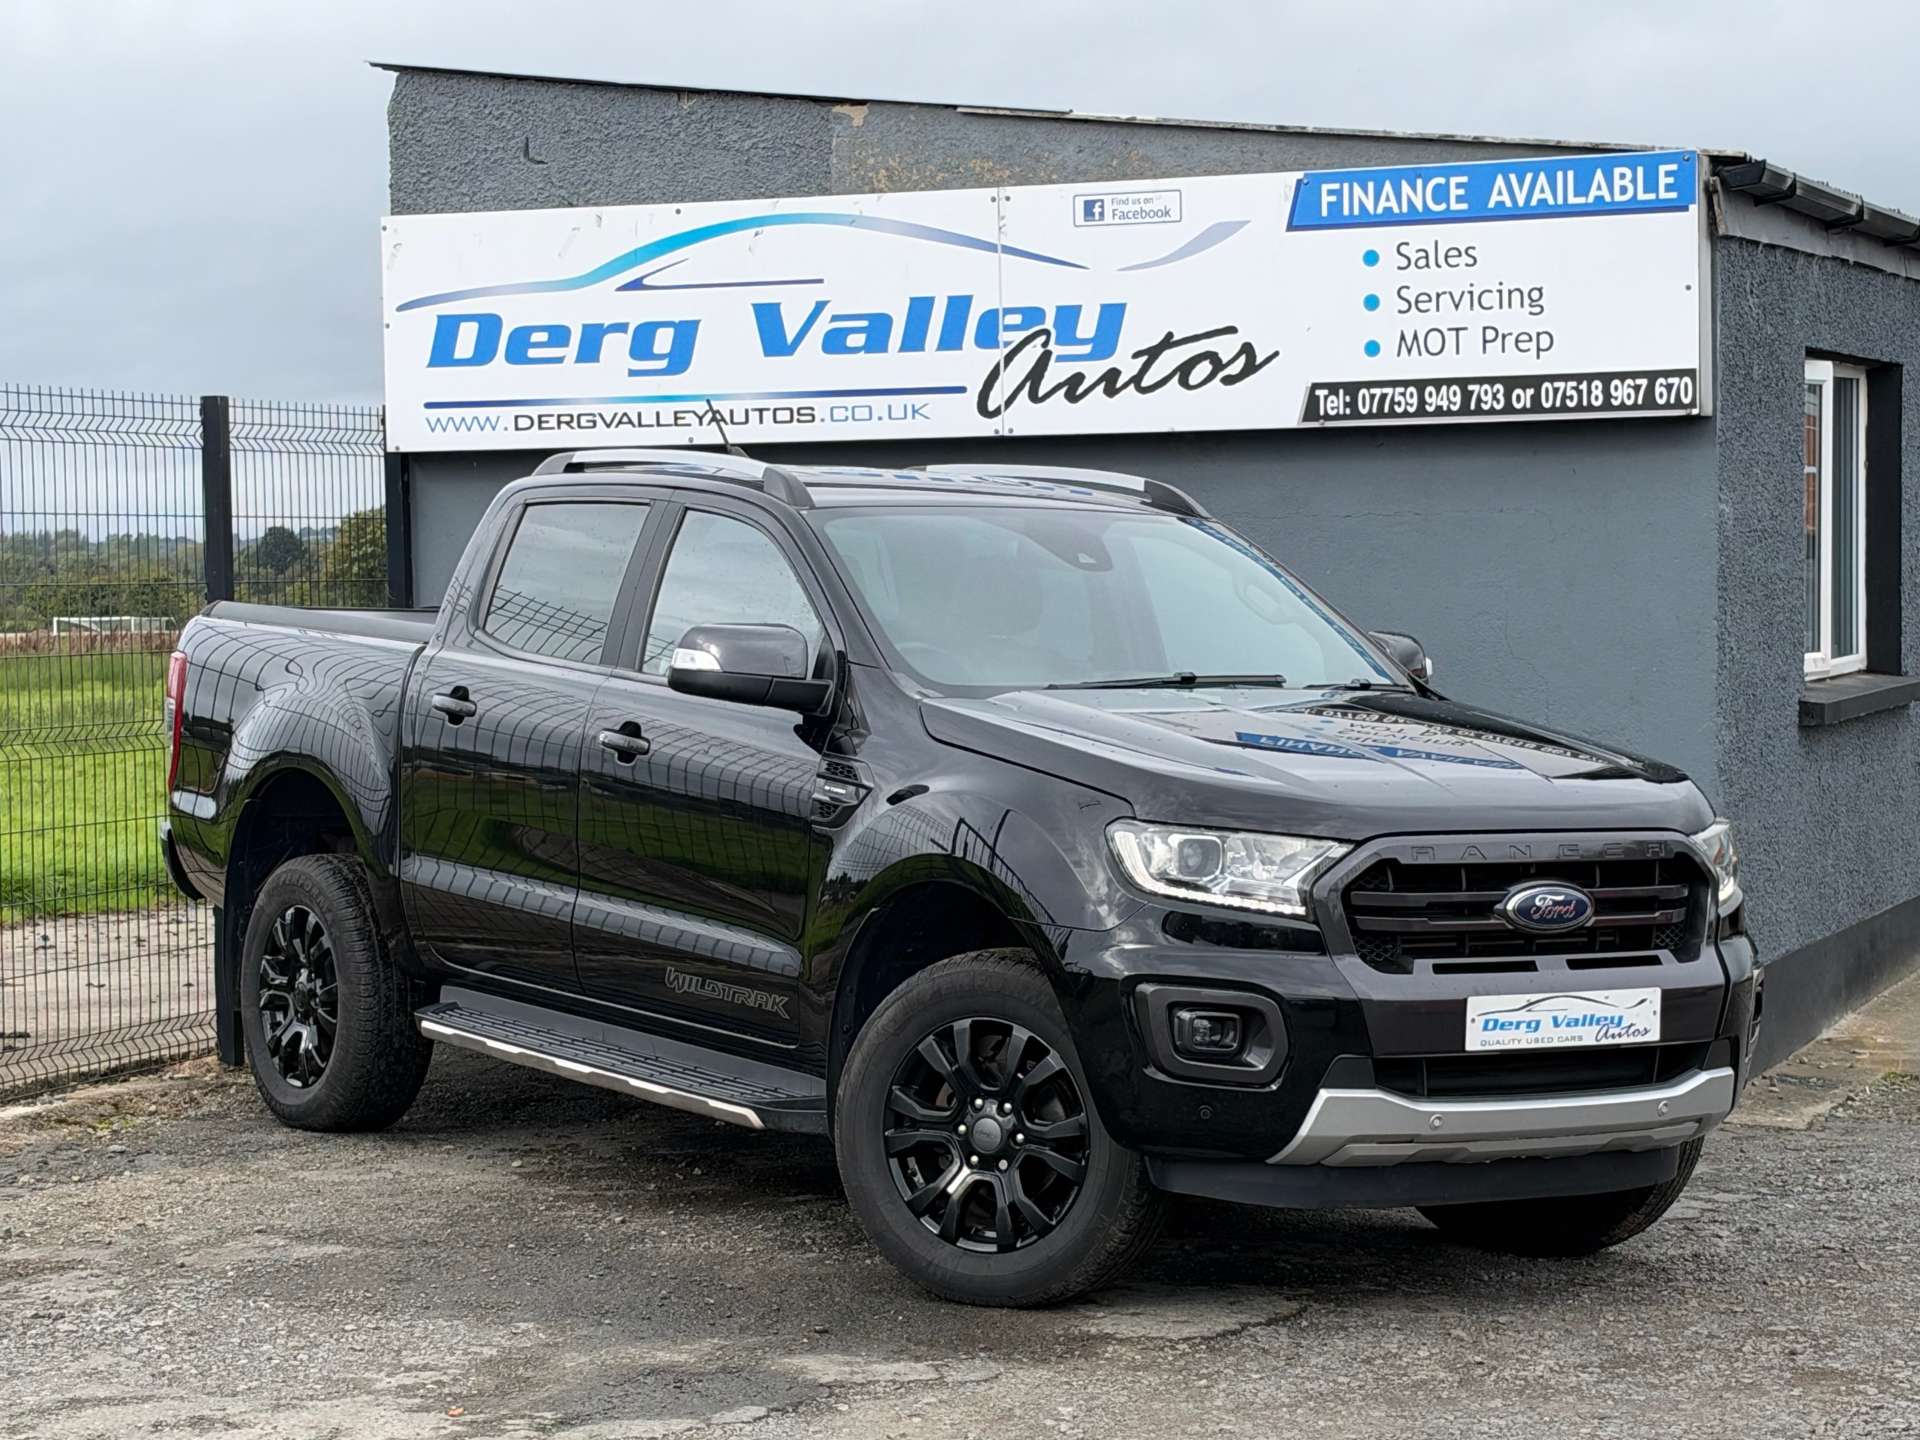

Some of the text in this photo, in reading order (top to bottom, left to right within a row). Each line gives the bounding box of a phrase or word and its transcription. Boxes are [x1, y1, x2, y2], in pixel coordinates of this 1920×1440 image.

[1111, 198, 1130, 206] Find
[1143, 197, 1154, 205] on
[1320, 163, 1679, 217] FINANCE AVAILABLE
[1111, 205, 1172, 221] Facebook
[1396, 240, 1478, 271] Sales
[1396, 282, 1545, 316] Servicing
[425, 294, 1128, 378] Derg Valley
[1396, 326, 1555, 360] MOT Prep
[976, 325, 1281, 420] Autos
[1315, 376, 1693, 416] Tel: 07759 949 793 or 07518 967 670
[1411, 842, 1667, 862] RANGER
[1530, 894, 1577, 920] Ford
[664, 966, 791, 1020] WILDTRAK
[1481, 1013, 1625, 1033] Derg Valley
[1594, 1022, 1652, 1043] Autos
[1479, 1035, 1584, 1047] QUALITY USED CARS
